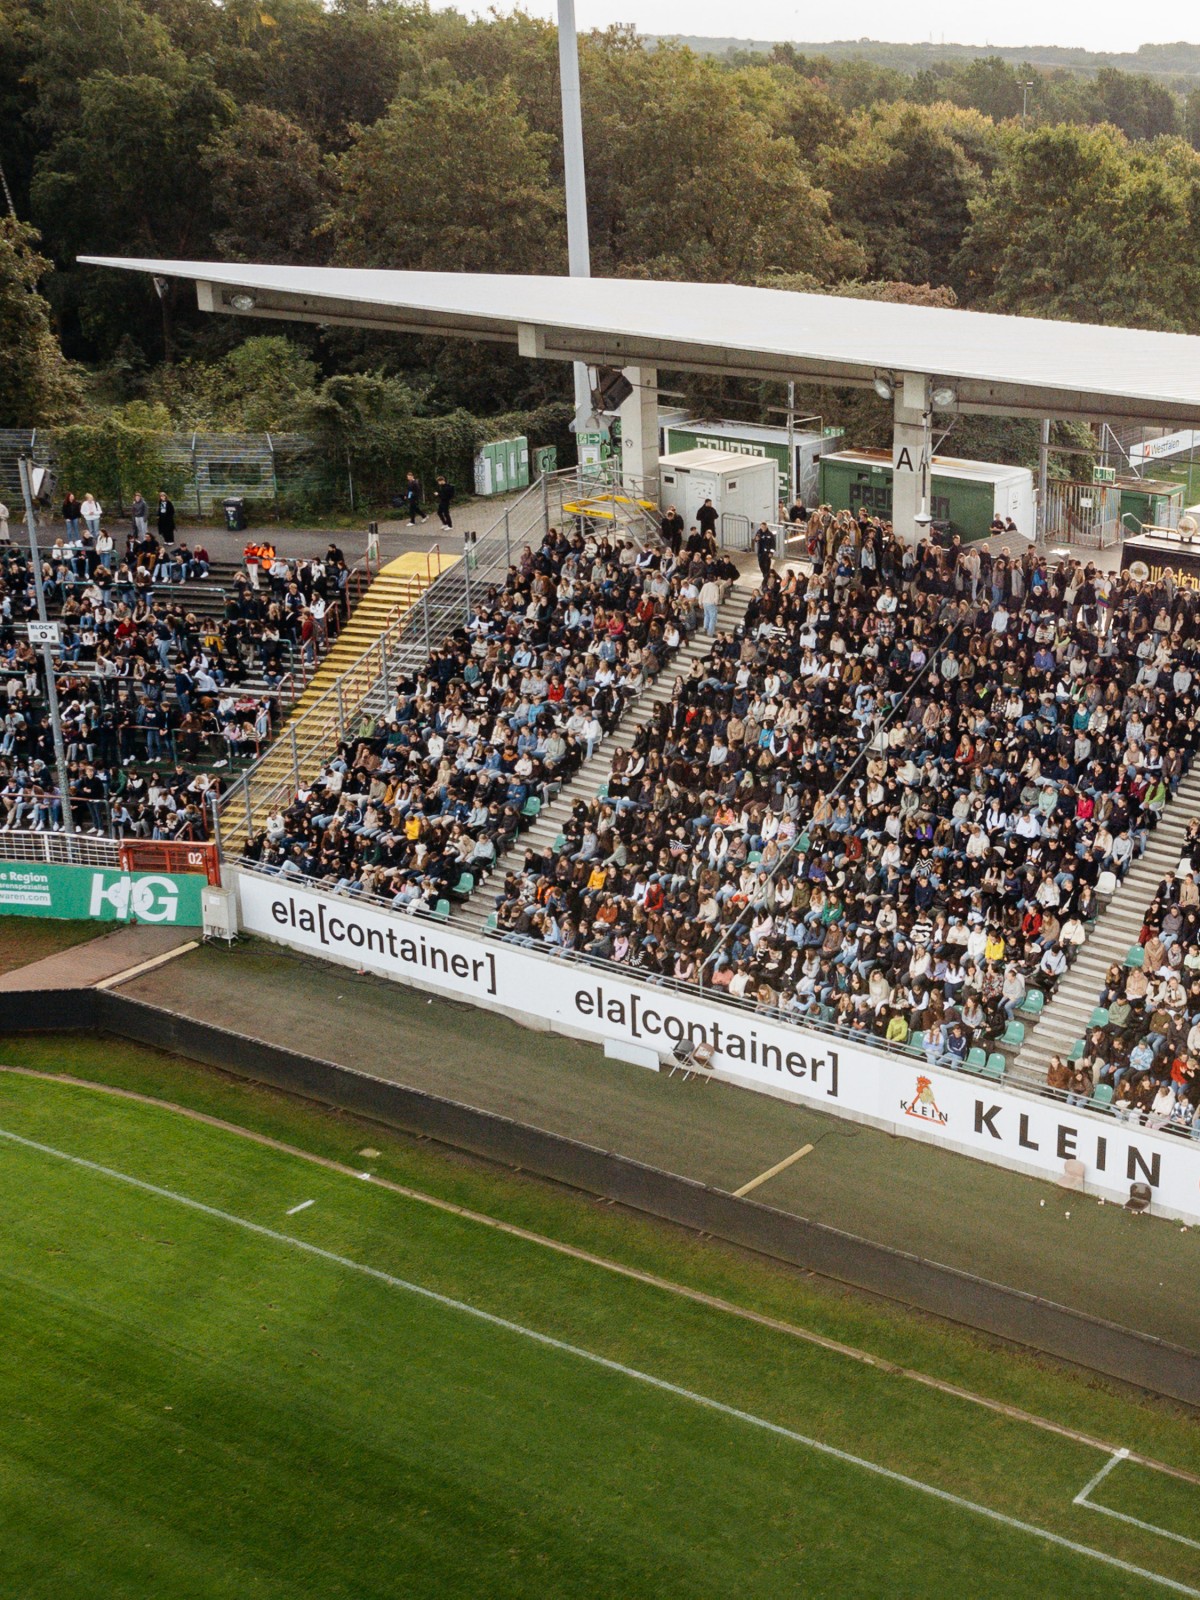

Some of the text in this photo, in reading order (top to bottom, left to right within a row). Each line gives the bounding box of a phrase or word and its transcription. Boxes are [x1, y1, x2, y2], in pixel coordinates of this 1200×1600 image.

[1151, 438, 1180, 456] Westfalen
[896, 447, 914, 472] A
[187, 852, 203, 865] 02
[9, 872, 48, 884] Region
[271, 897, 497, 995] ela[container]
[575, 986, 839, 1097] ela[container]
[900, 1099, 948, 1122] KLEIN
[974, 1099, 1161, 1187] KLEIN
